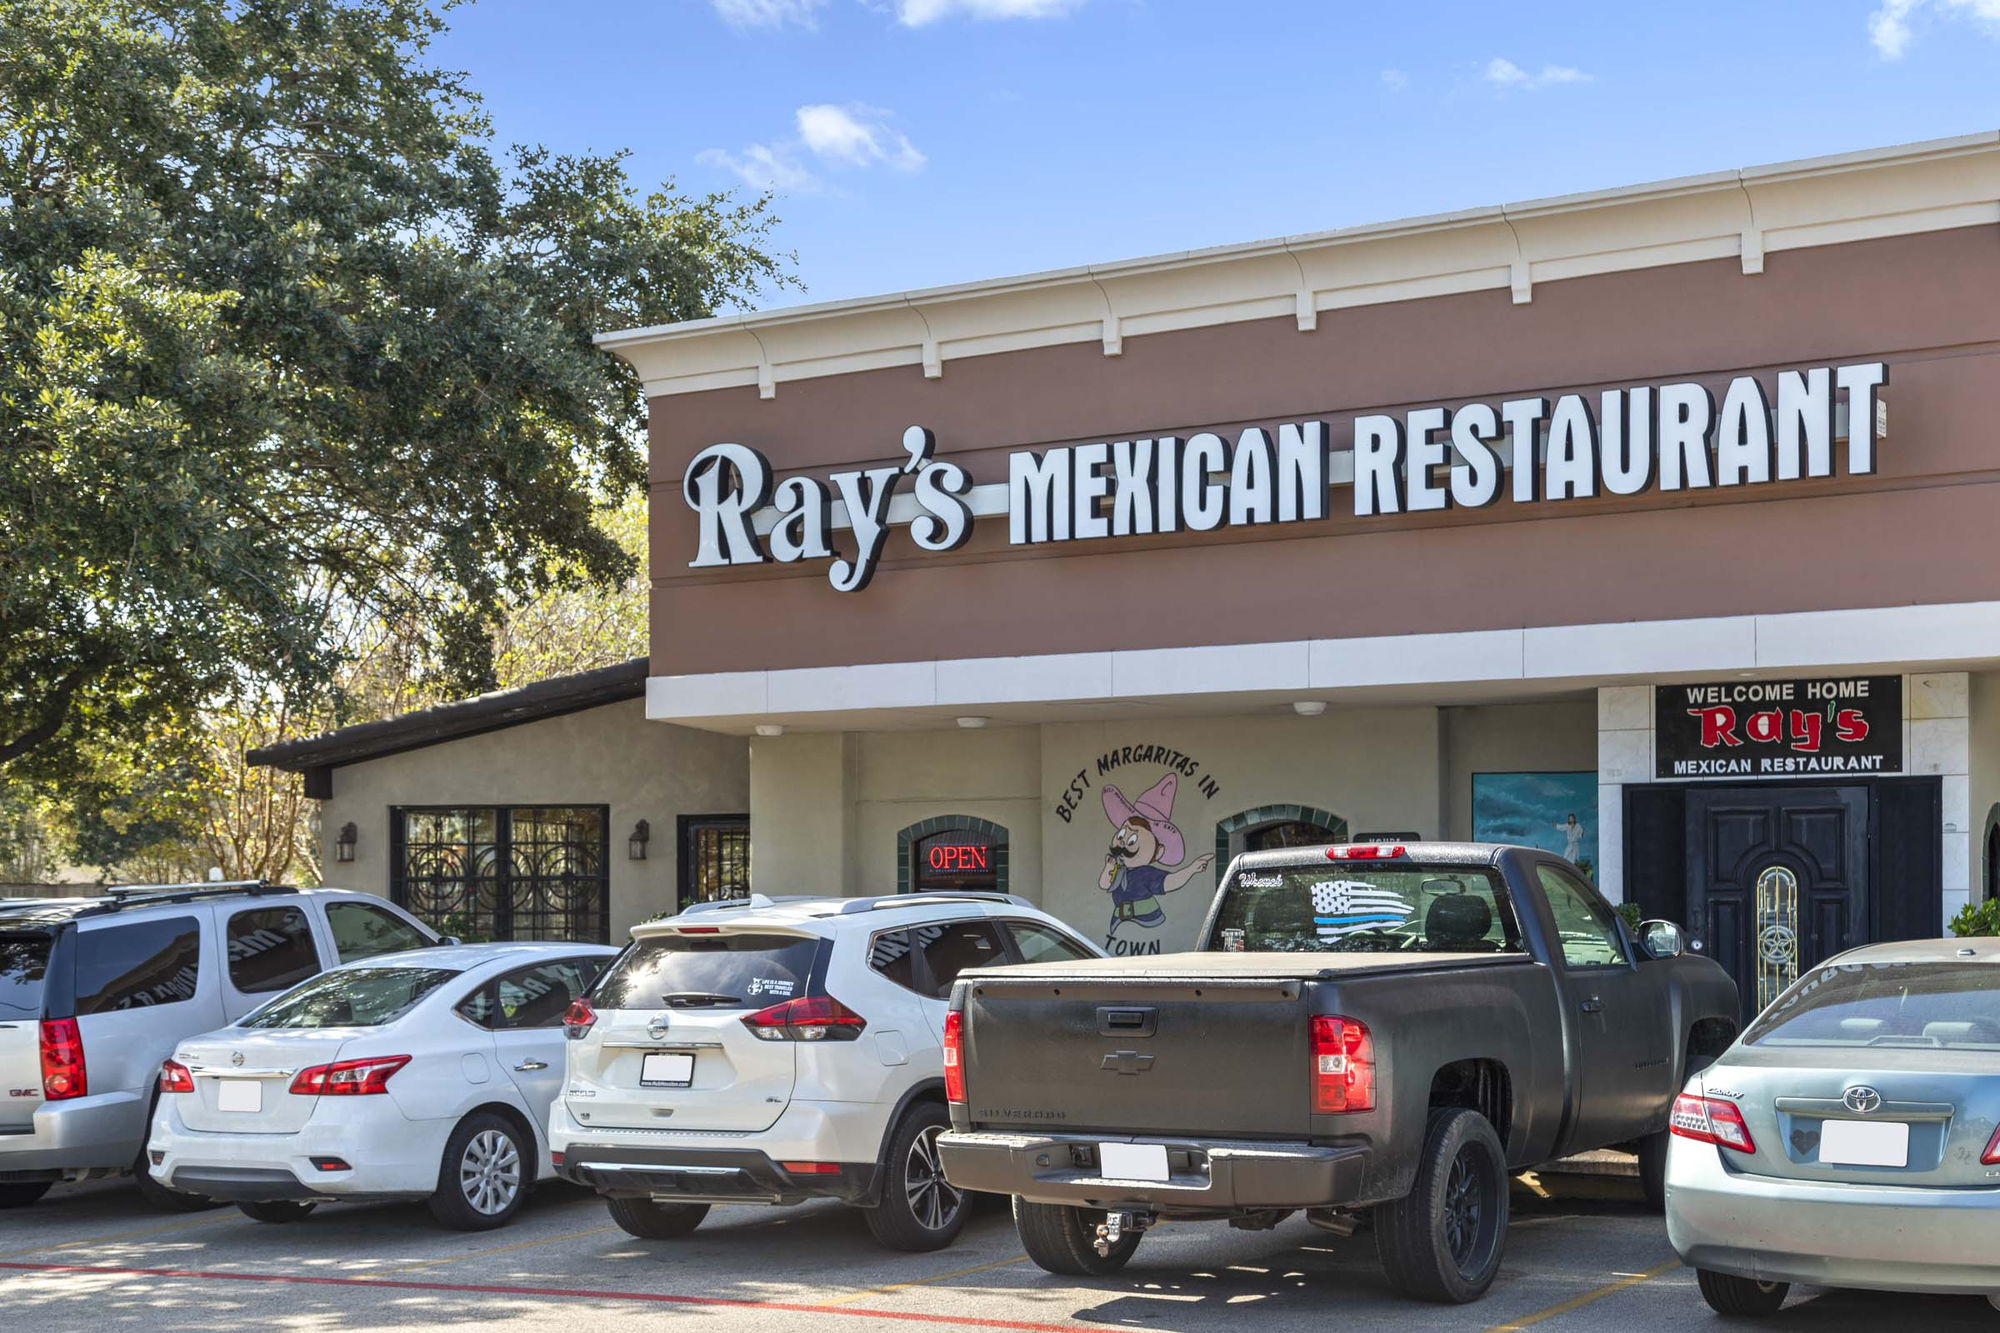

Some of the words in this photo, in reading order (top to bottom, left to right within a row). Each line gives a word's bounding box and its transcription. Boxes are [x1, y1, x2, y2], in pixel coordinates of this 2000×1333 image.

[683, 425, 973, 593] Ray's
[1009, 420, 1329, 546] MEXICAN
[1353, 362, 1889, 517] RESTAURANT
[1687, 684, 1794, 703] WELCOME
[1807, 680, 1870, 700] HOME
[1687, 700, 1869, 752] Ray's
[1674, 759, 1751, 775] MEXICAN
[1761, 755, 1884, 772] RESTAURANT
[1056, 769, 1091, 823] BEST
[1097, 744, 1200, 777] MARGARITAS
[1198, 774, 1220, 800] IN
[929, 845, 988, 870] OPEN
[1104, 934, 1161, 957] TOWN
[9, 1088, 39, 1097] GMC
